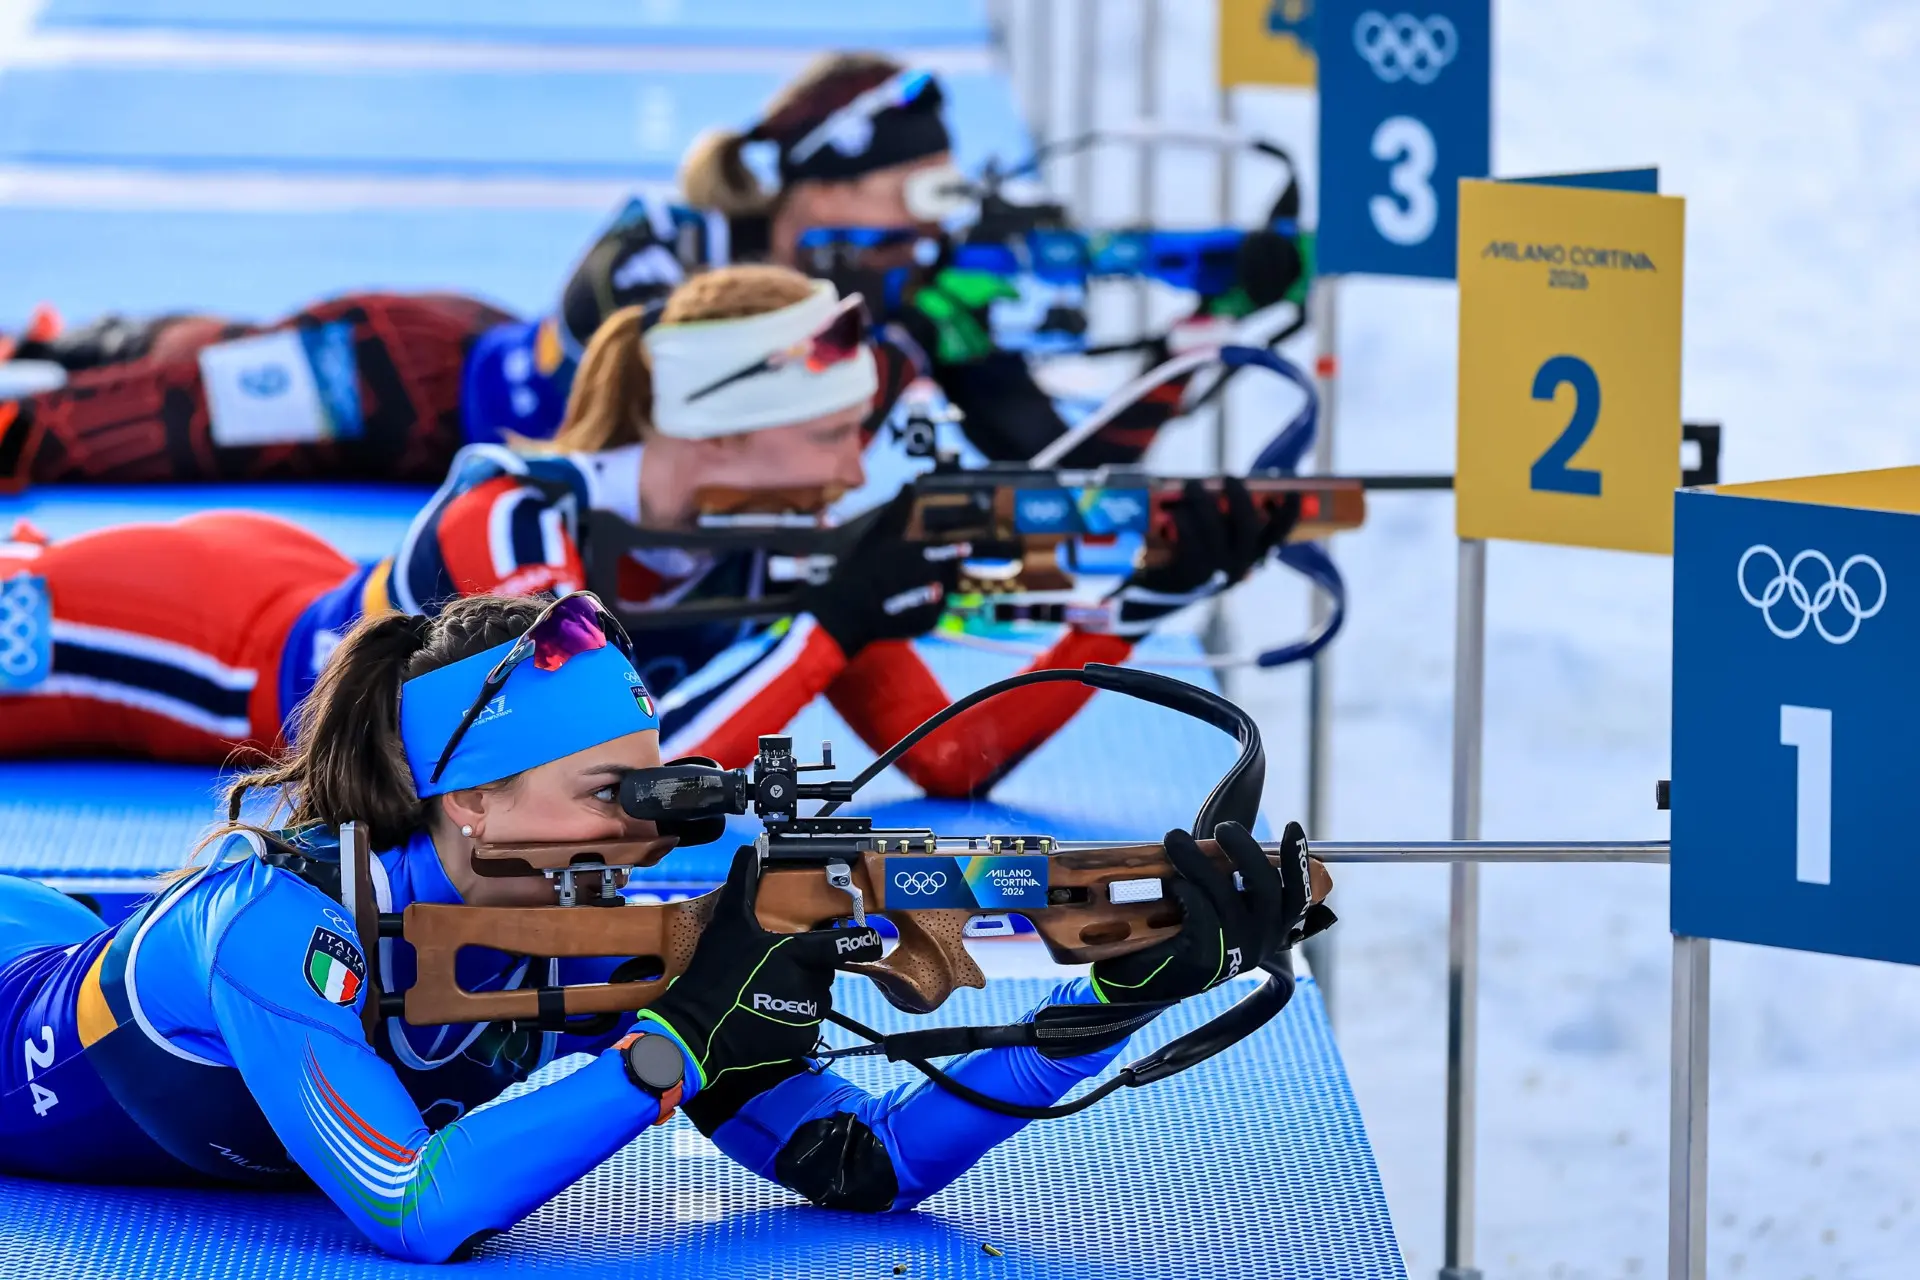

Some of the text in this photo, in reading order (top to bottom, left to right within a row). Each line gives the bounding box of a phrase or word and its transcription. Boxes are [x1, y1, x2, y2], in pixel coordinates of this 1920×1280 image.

[1369, 115, 1438, 245] 3
[1481, 241, 1657, 272] MILANO CORTINA
[1548, 268, 1589, 290] 2026
[1530, 354, 1602, 497] 2
[1780, 704, 1832, 885] 1
[985, 869, 1032, 878] MILANO
[993, 878, 1041, 887] CORTINA
[1002, 887, 1025, 896] 2026
[319, 932, 364, 973] ITALIA
[328, 944, 359, 971] TEAM
[25, 1026, 59, 1117] 24
